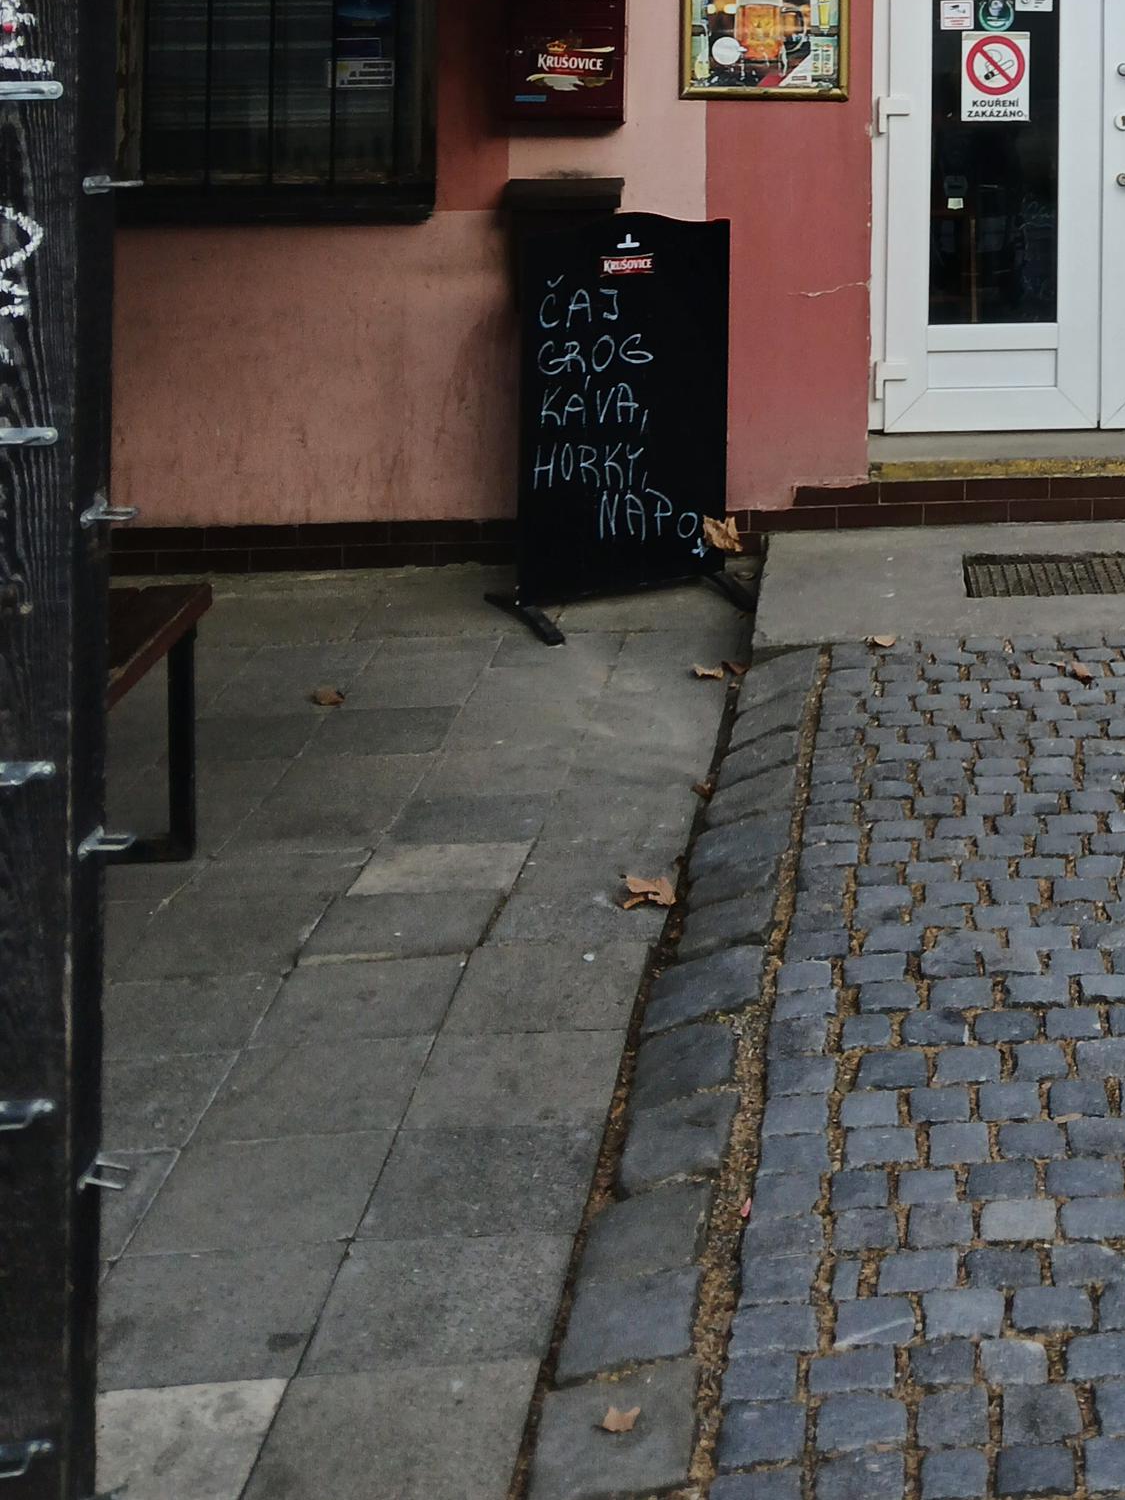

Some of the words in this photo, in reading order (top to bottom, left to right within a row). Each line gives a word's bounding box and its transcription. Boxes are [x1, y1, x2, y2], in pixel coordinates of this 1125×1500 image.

[537, 53, 604, 72] KRUŠOVICE
[972, 98, 1019, 108] KOUŘENÍ
[967, 108, 1024, 118] ZAKÁZÁNO
[603, 258, 653, 274] KRUŠOVICE
[539, 274, 619, 329] ČAJ
[537, 333, 654, 376] GROG
